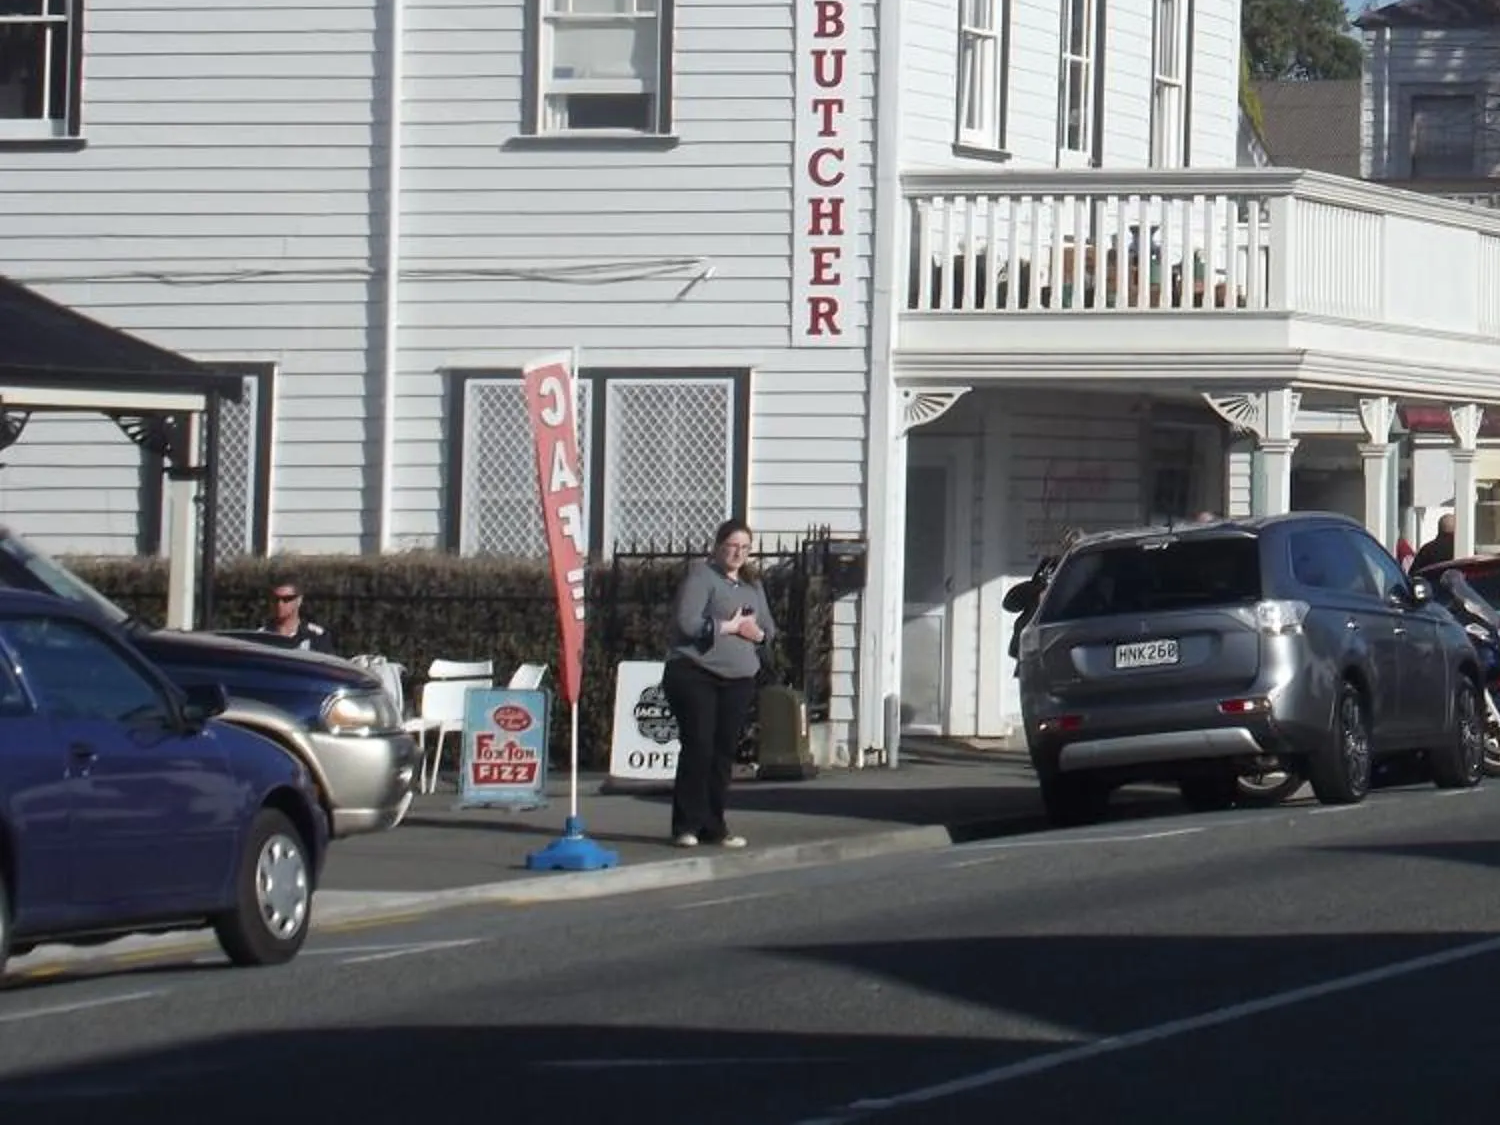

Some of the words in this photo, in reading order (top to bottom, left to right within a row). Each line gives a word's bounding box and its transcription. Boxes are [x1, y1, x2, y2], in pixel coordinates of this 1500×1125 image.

[806, 0, 846, 335] BUTCHER
[628, 751, 676, 769] OPE
[479, 765, 529, 780] FIZZ
